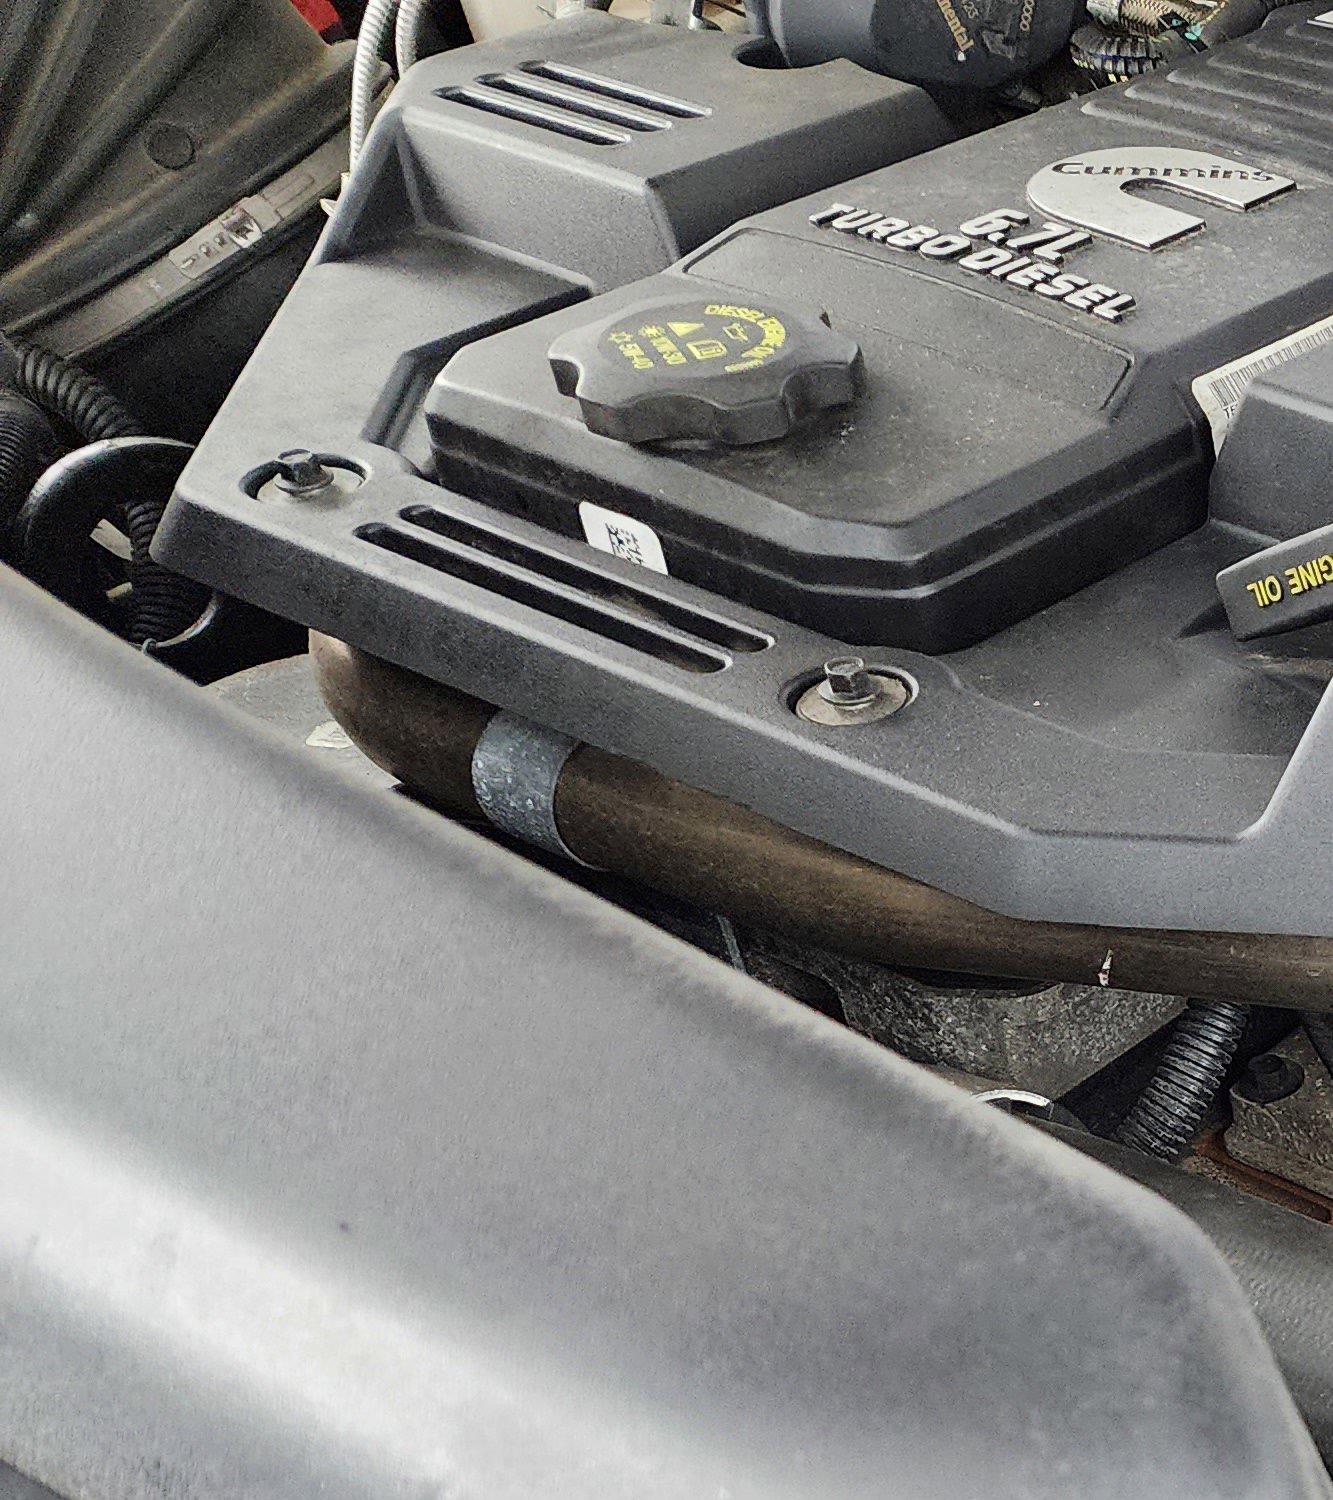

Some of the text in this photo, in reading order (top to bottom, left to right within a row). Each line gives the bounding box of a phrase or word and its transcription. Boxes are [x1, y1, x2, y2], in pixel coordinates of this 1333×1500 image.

[809, 203, 1137, 323] TURBO DIESEL
[959, 207, 1093, 265] 6.7L
[1246, 575, 1285, 608] OIL
